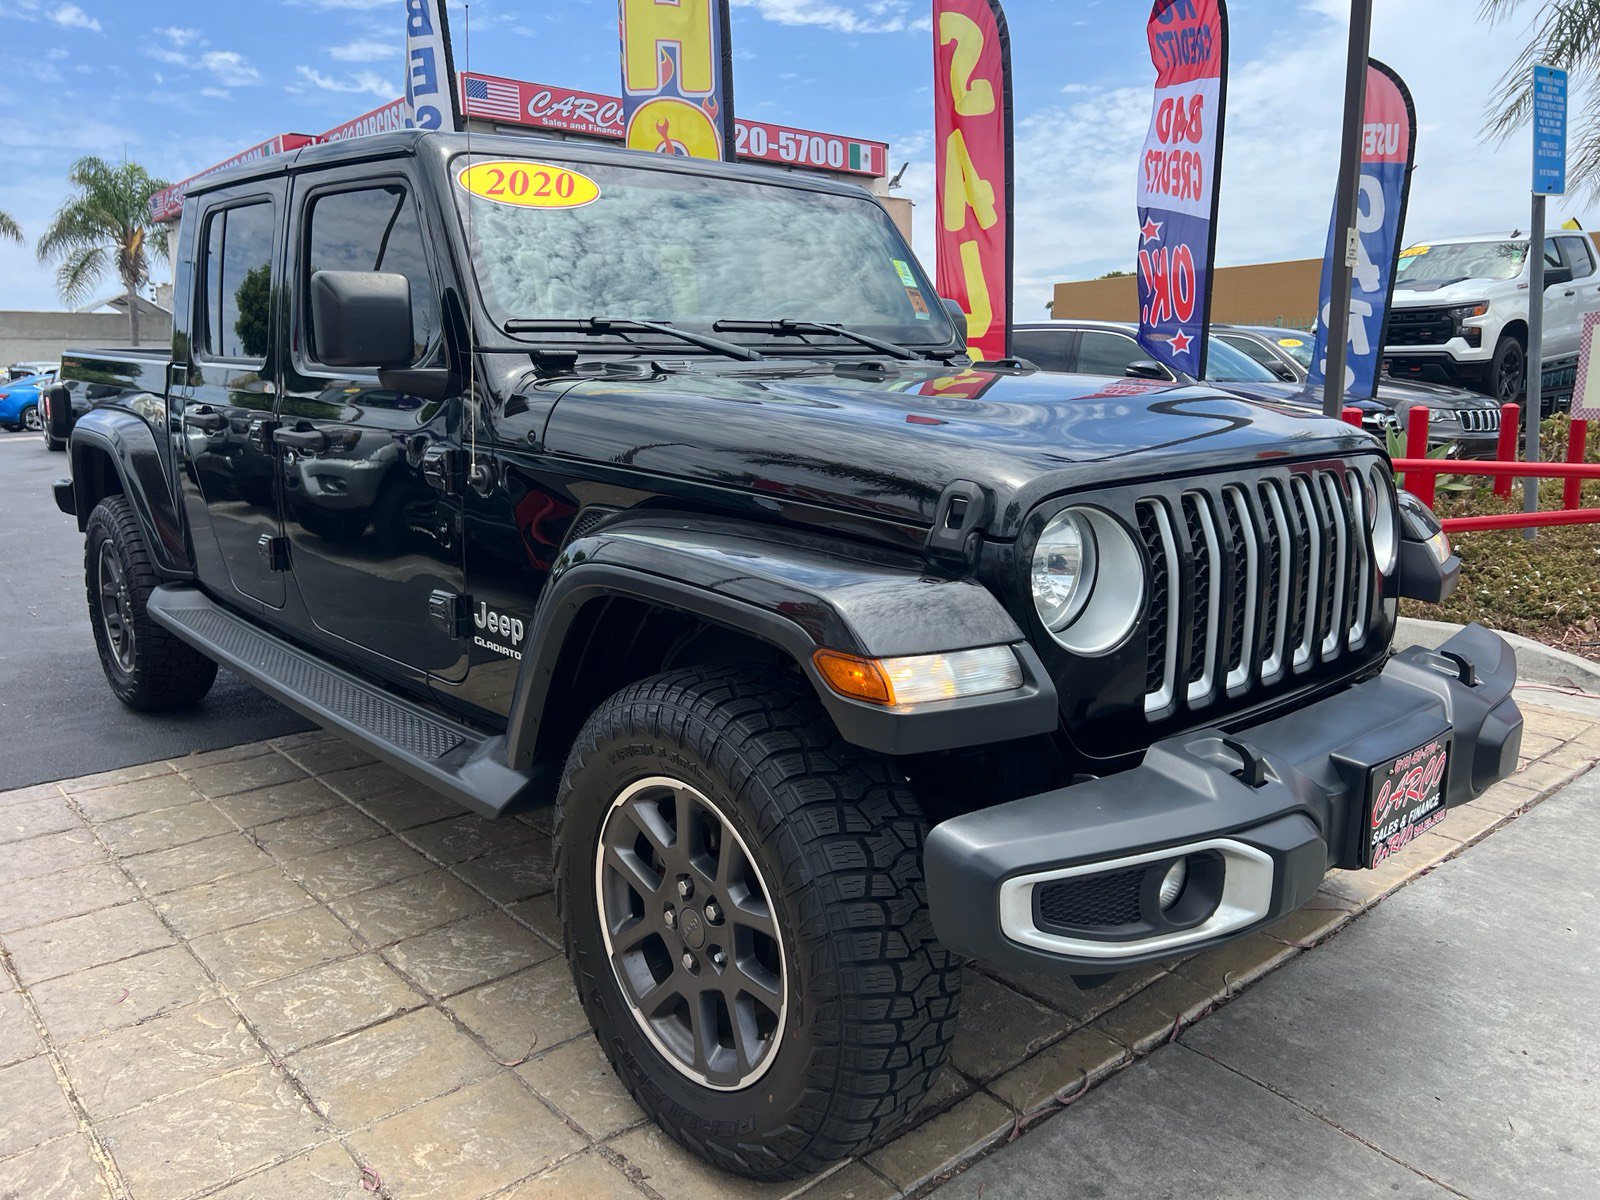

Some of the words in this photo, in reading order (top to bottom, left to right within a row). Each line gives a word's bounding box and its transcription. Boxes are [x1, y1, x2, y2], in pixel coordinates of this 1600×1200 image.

[542, 117, 567, 128] Sales
[569, 123, 586, 131] and
[588, 124, 622, 136] Finance
[486, 169, 575, 198] 2020
[473, 601, 524, 646] Jeep
[473, 635, 523, 661] GLADIATO
[1371, 751, 1447, 829] CARCO
[1371, 818, 1400, 846] SALES
[1399, 814, 1407, 829] &
[1407, 792, 1441, 822] FINANCE
